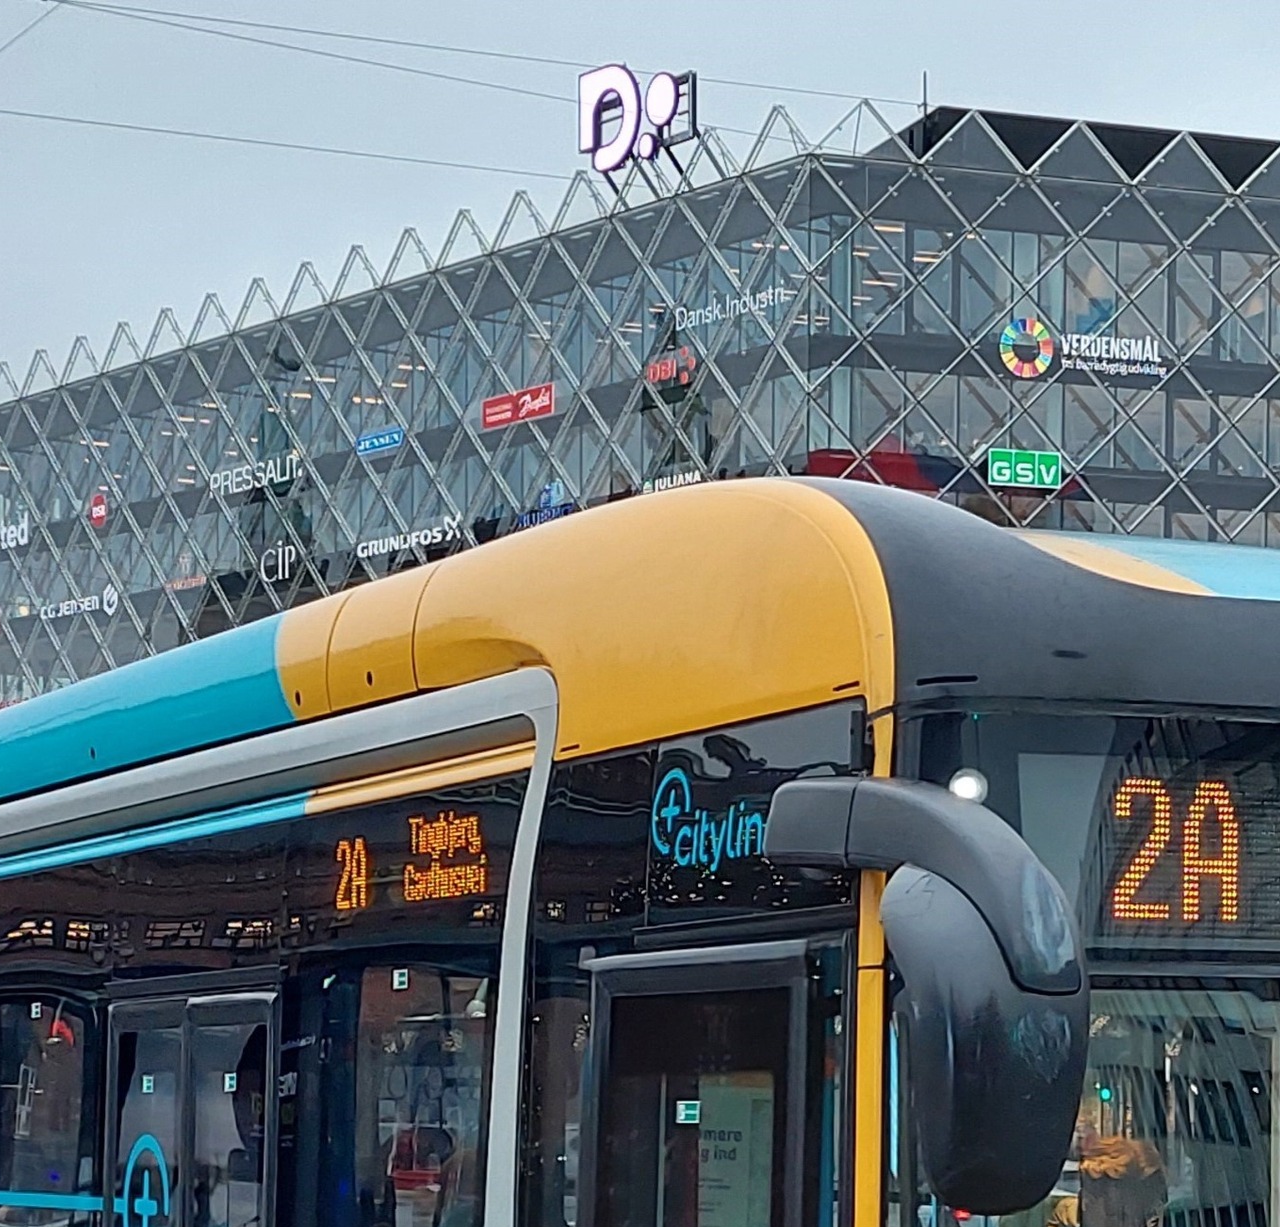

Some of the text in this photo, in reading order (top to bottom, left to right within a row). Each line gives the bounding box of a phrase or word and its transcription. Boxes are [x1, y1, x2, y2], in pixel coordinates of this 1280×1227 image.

[992, 461, 1056, 484] GSV
[675, 802, 762, 872] citylin
[1112, 777, 1239, 921] 2A
